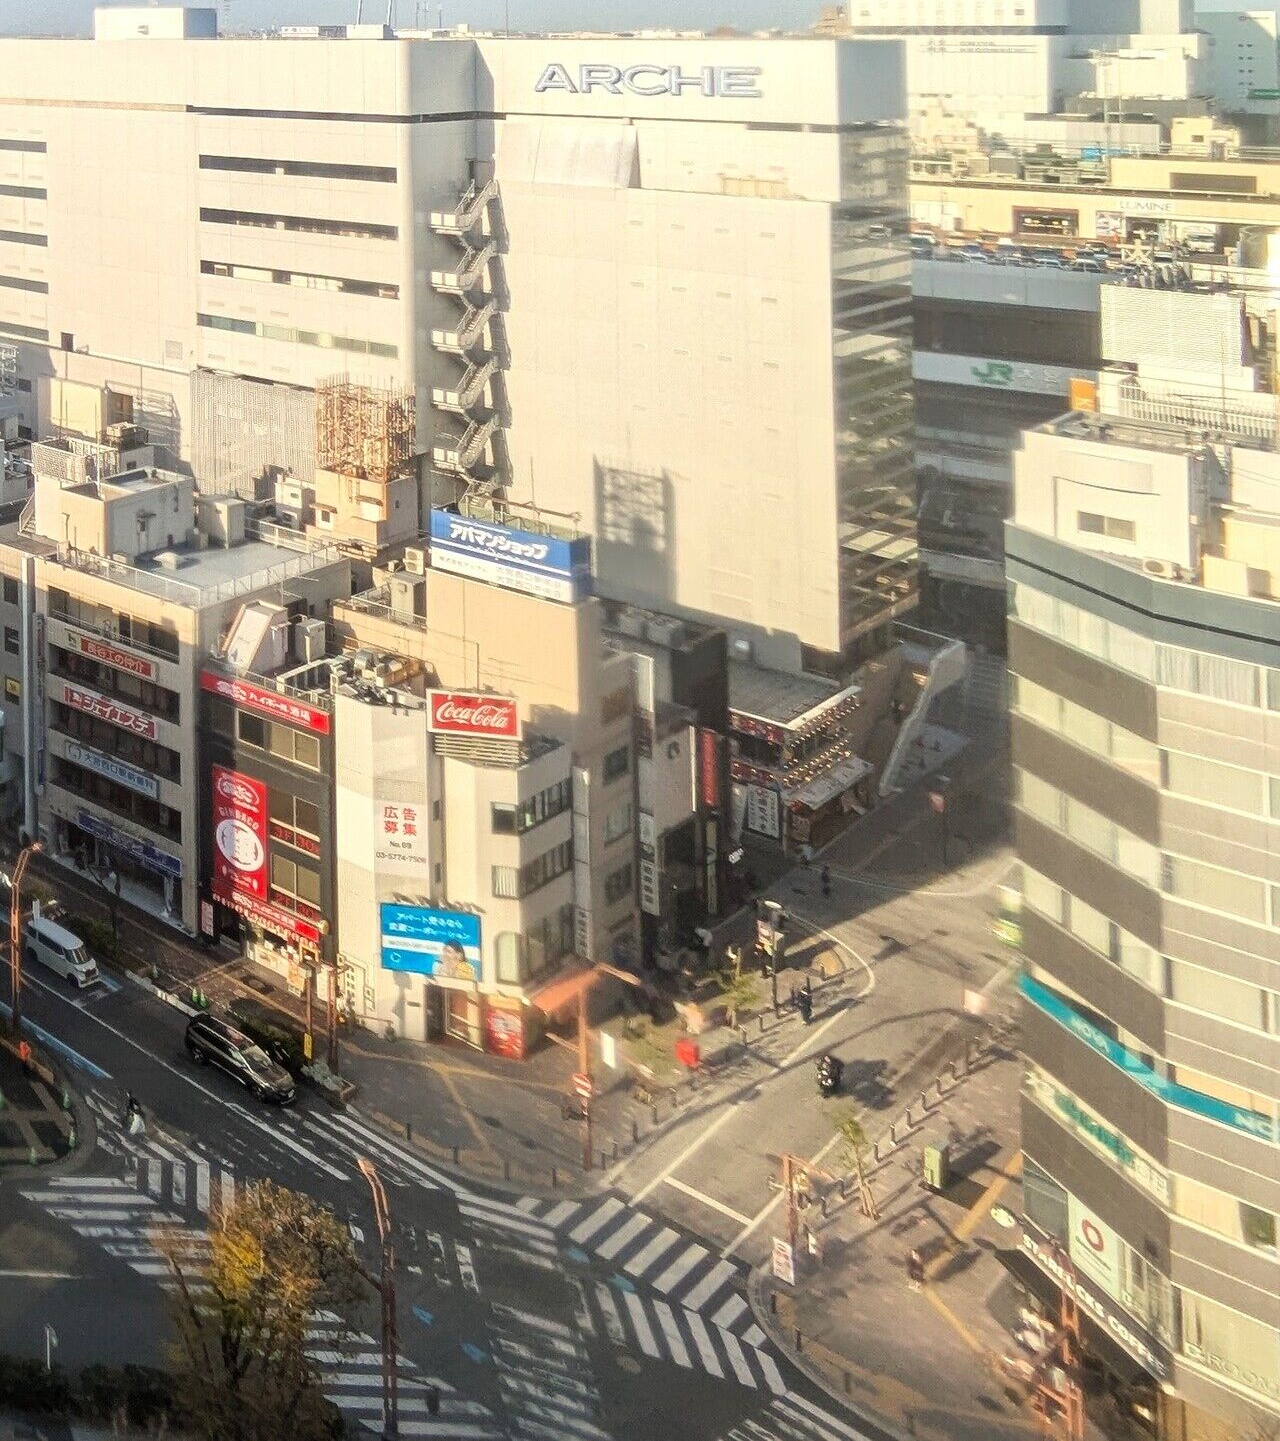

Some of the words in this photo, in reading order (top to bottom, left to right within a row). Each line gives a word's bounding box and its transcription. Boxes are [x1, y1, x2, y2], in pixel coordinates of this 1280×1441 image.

[535, 63, 763, 98] ARCHE
[1120, 201, 1173, 212] LUMINE
[970, 362, 1014, 386] JR
[450, 523, 550, 560] アパマンショップ
[87, 642, 145, 673] 長谷工の仲介
[383, 806, 417, 821] 広告
